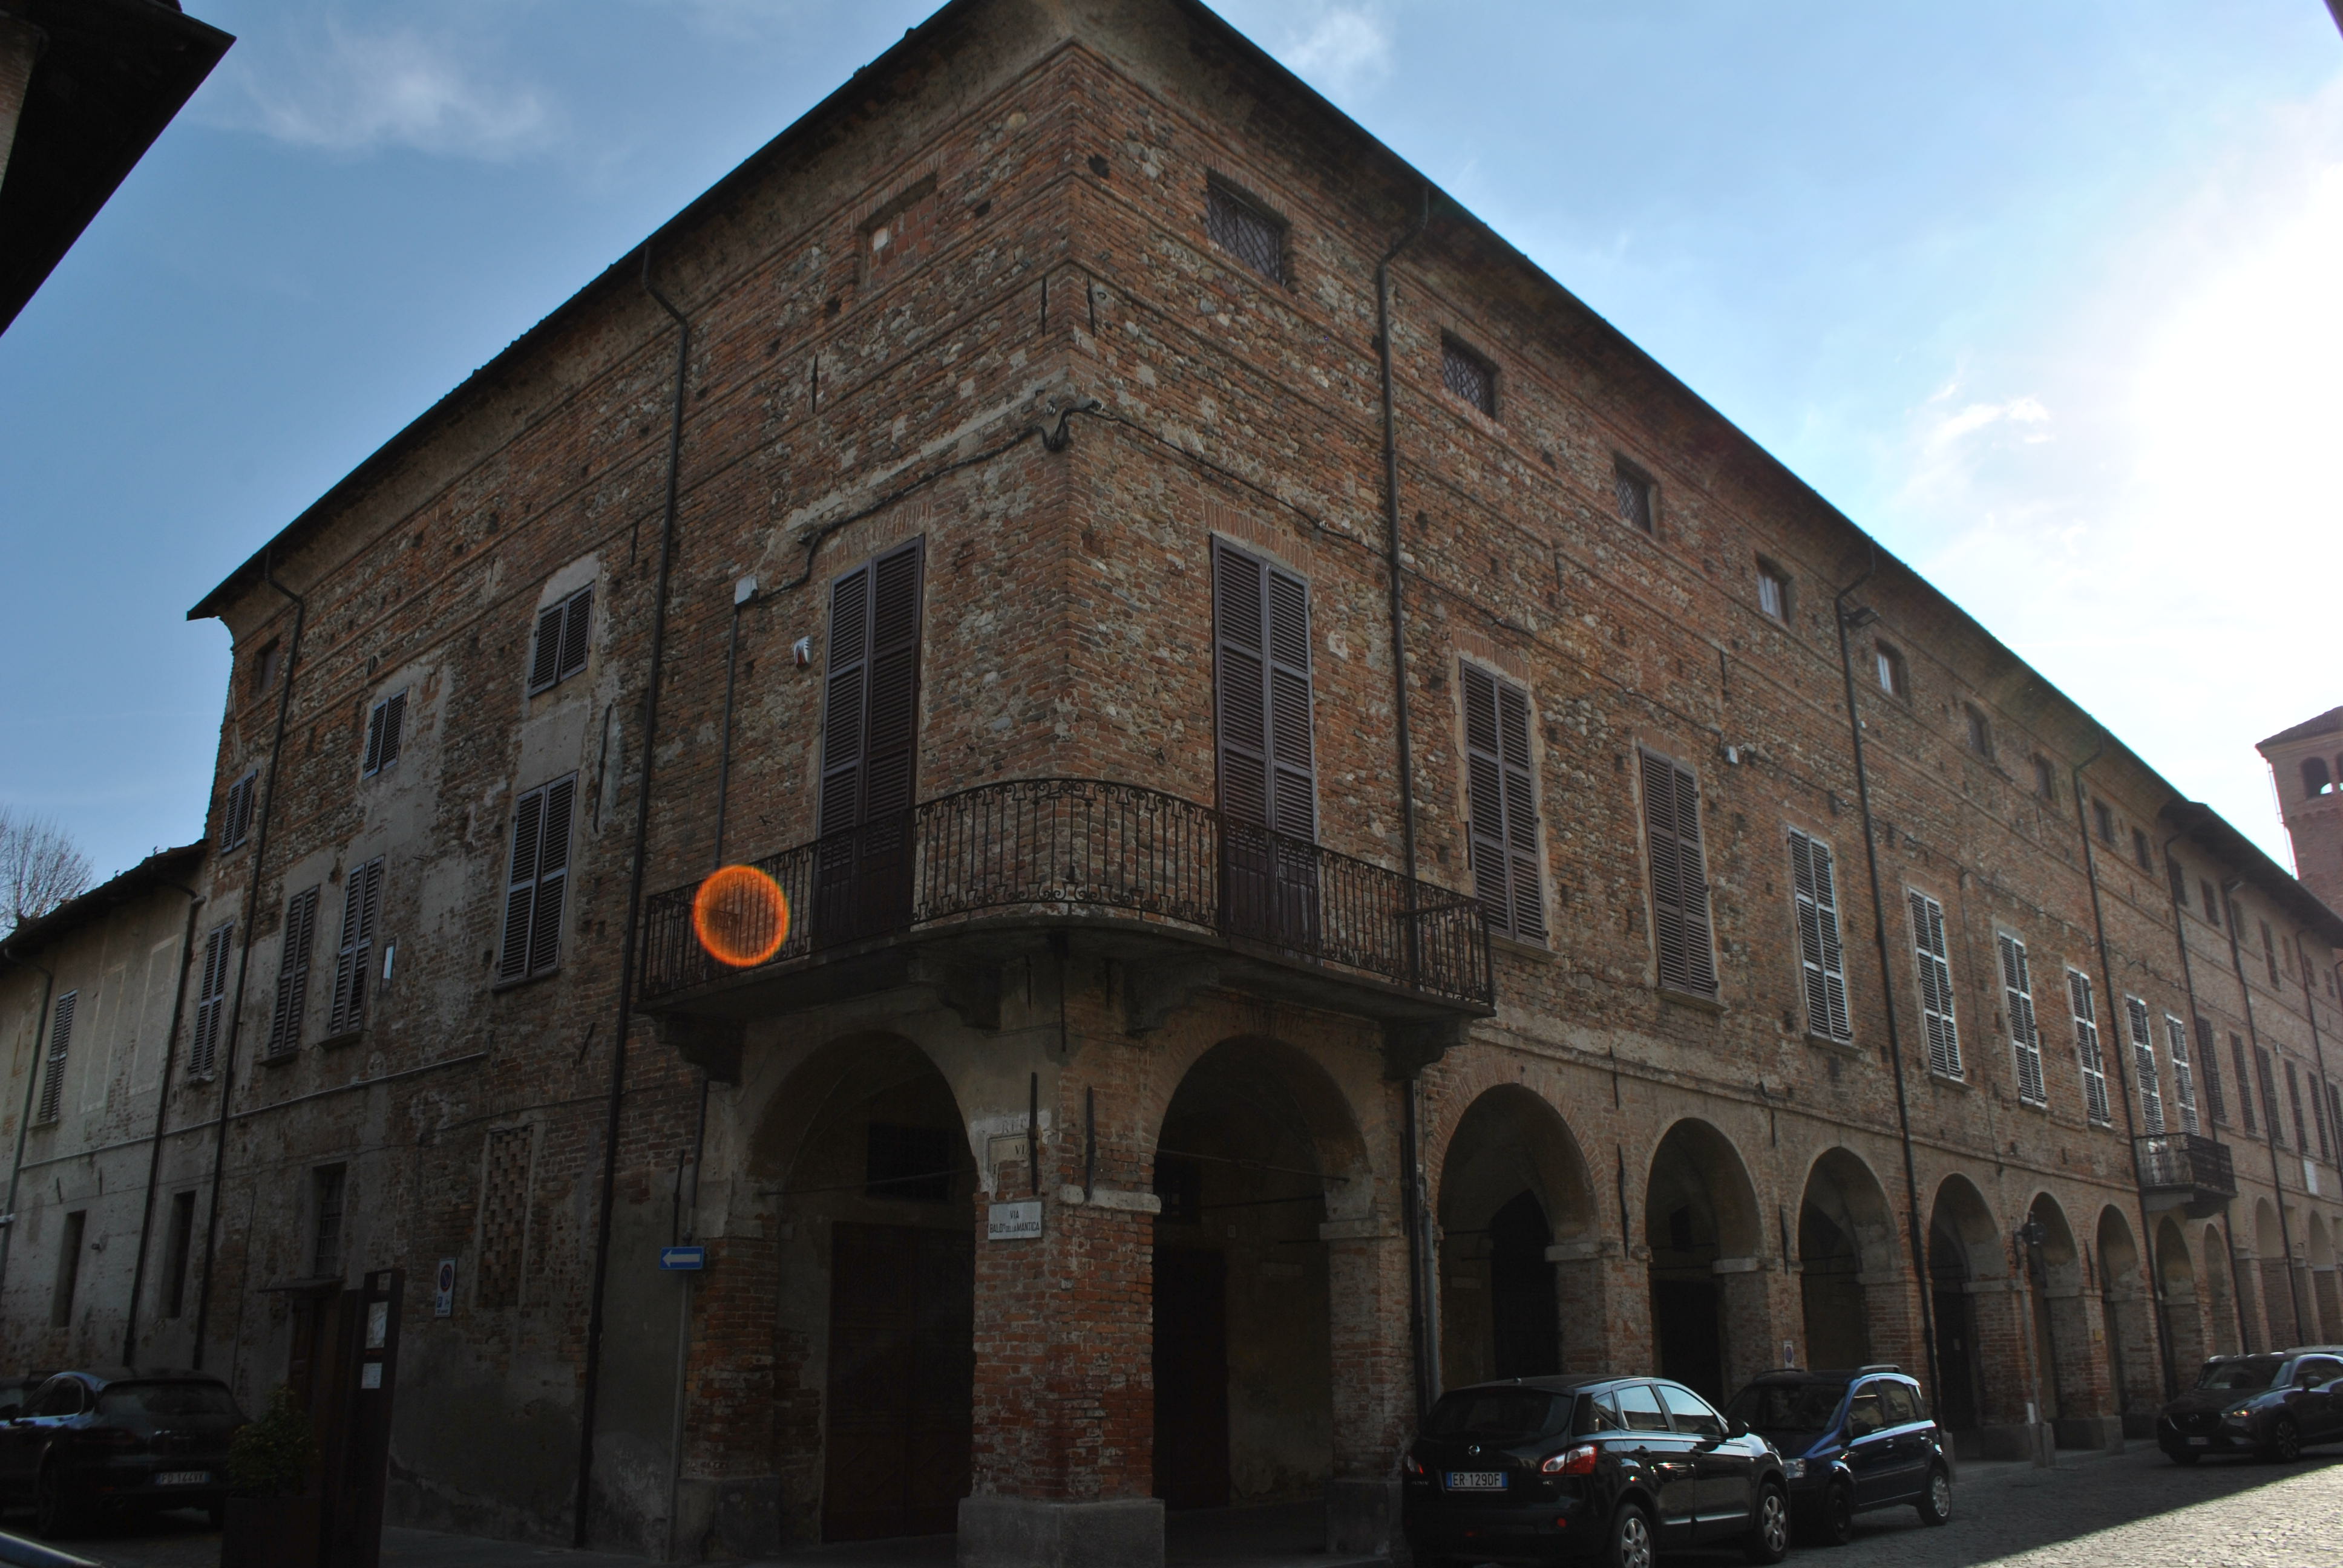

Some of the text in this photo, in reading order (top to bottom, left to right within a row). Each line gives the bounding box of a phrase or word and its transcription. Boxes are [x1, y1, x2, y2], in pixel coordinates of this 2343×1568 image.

[1010, 1210, 1020, 1219] VIA
[1017, 1221, 1040, 1232] MANTICA
[1453, 1474, 1501, 1486] ER 129DF
